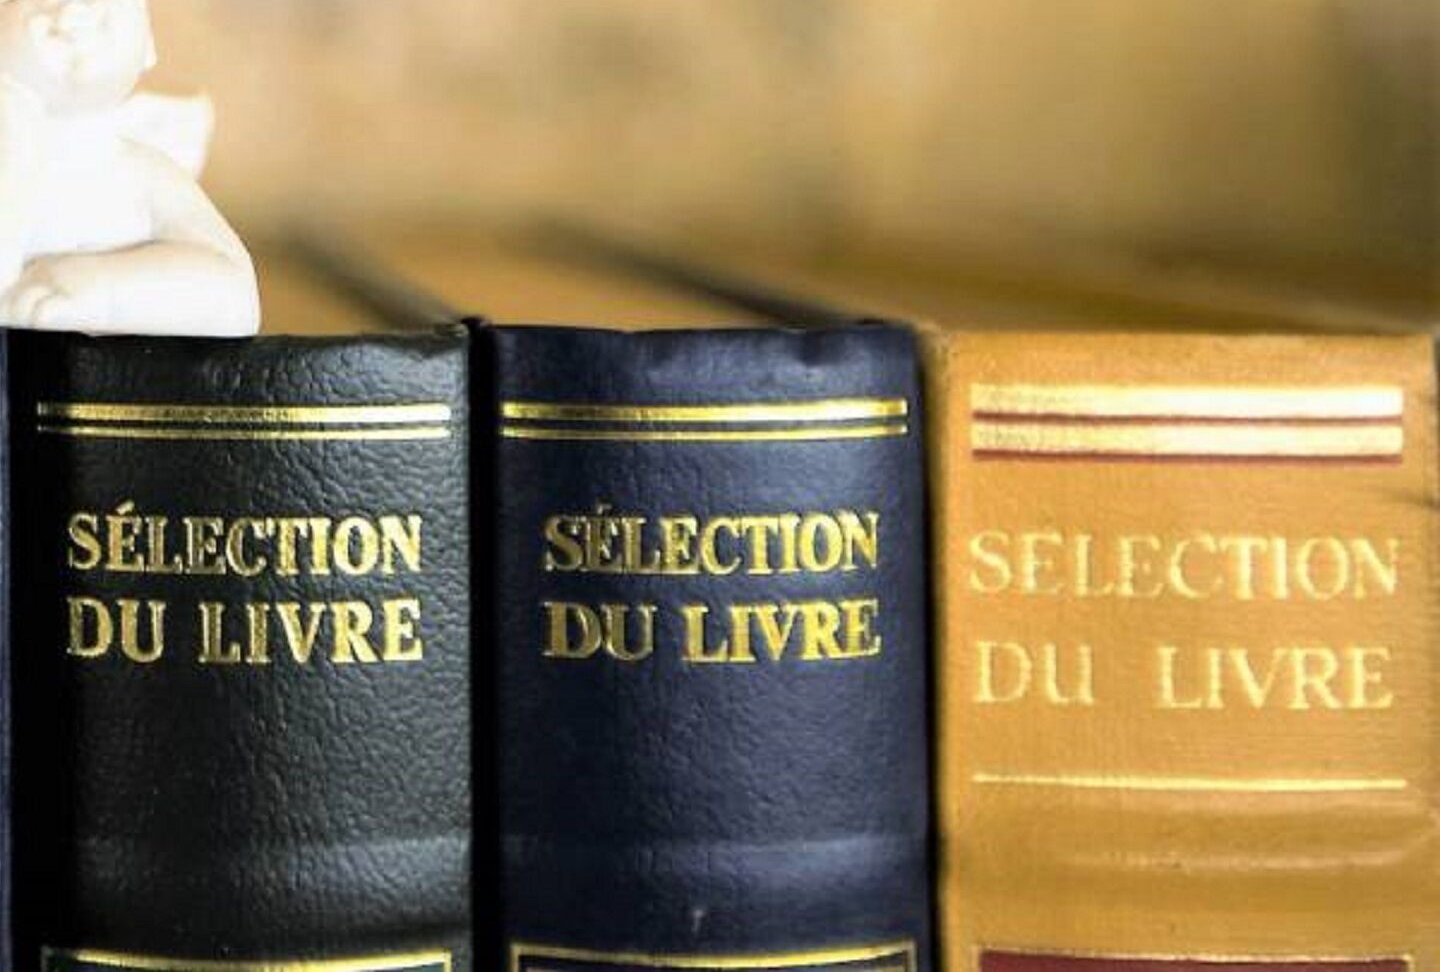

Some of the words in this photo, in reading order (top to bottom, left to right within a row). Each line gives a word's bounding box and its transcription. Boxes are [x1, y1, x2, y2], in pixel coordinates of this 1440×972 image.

[67, 501, 422, 576] SÉLECTION
[541, 502, 880, 576] SÉLECTION
[67, 598, 165, 663] DU
[197, 598, 423, 664] LIVRE
[540, 602, 658, 662] DU
[680, 599, 882, 663] LIVRE
[975, 642, 1094, 705] DU
[1158, 645, 1394, 710] LIVRE
